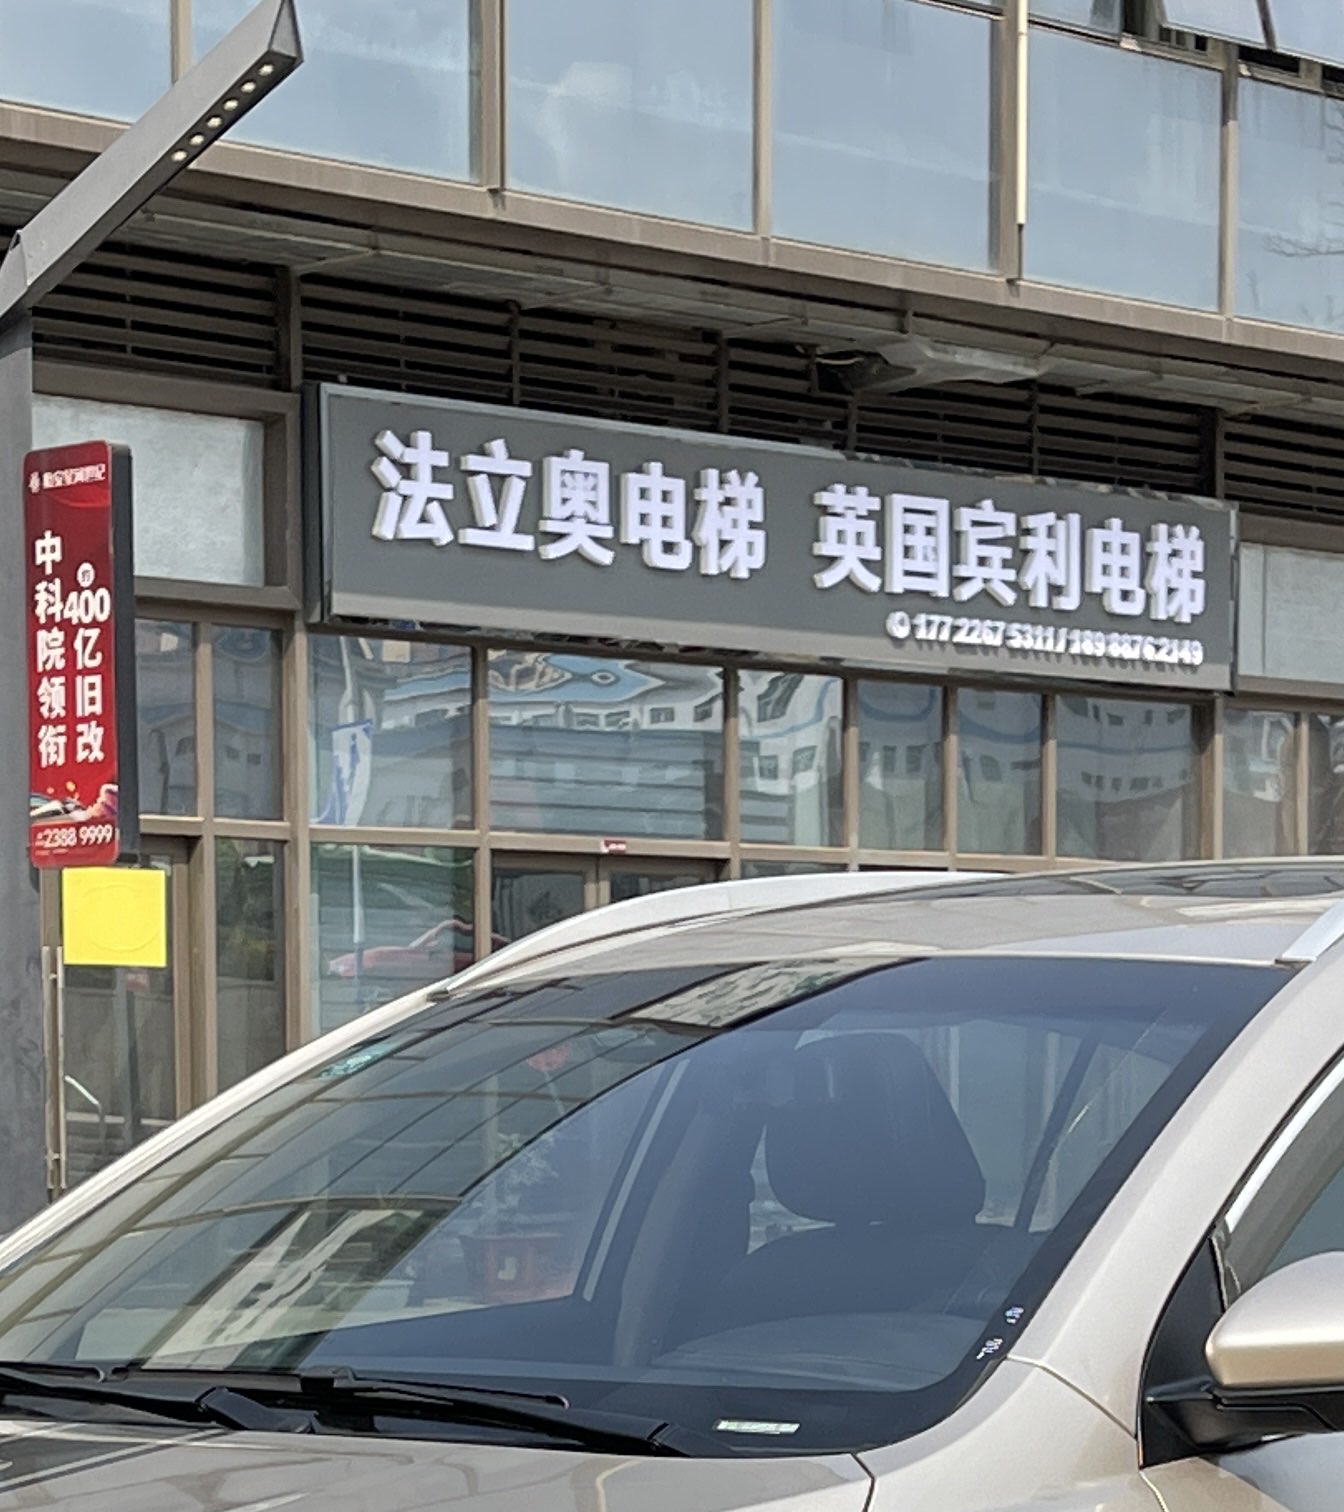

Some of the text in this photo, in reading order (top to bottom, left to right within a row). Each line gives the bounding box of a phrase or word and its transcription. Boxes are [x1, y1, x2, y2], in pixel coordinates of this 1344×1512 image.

[369, 429, 1206, 626] 法立奥电梯 英国宾利电梯
